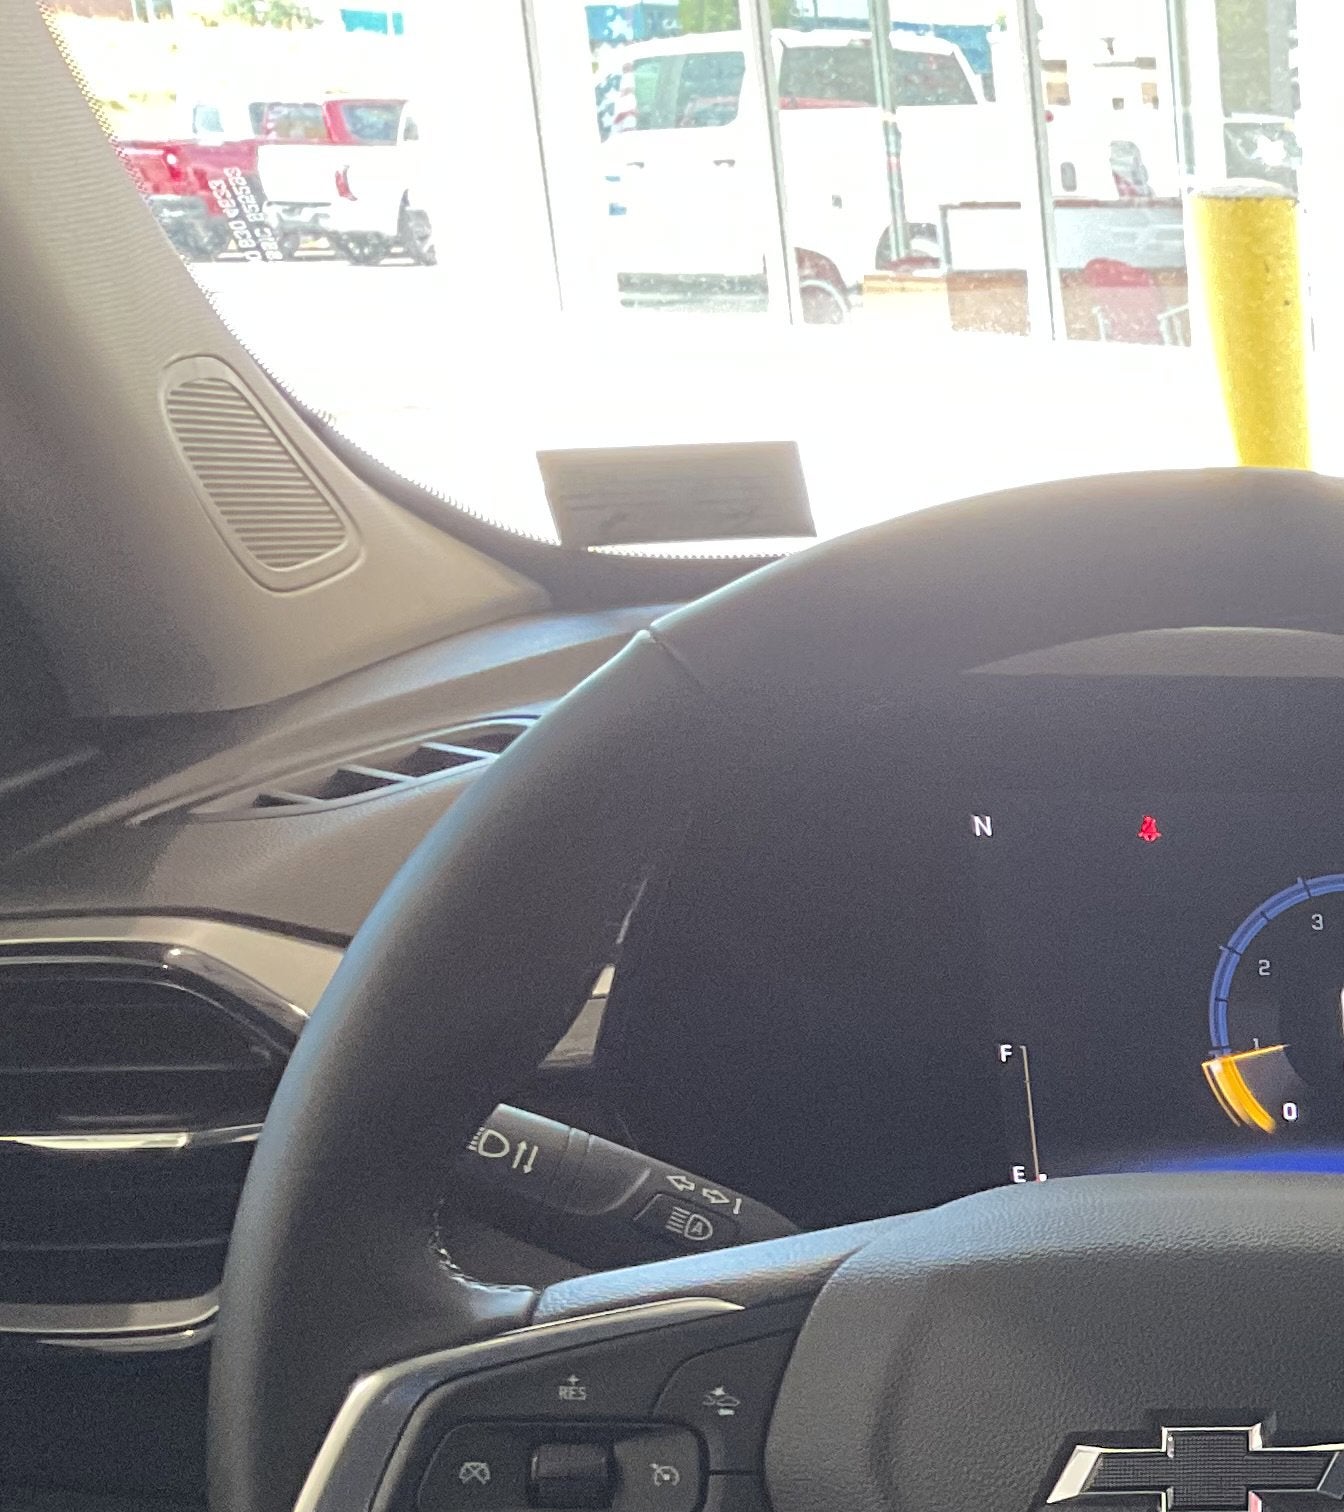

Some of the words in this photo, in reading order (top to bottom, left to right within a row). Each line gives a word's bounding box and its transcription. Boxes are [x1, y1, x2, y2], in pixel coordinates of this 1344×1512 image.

[972, 815, 993, 837] N
[1311, 914, 1324, 931] 3
[1258, 960, 1271, 976] 2
[1000, 1045, 1013, 1063] F
[1282, 1102, 1298, 1121] 0
[1012, 1166, 1027, 1183] E
[558, 1386, 587, 1401] RES
